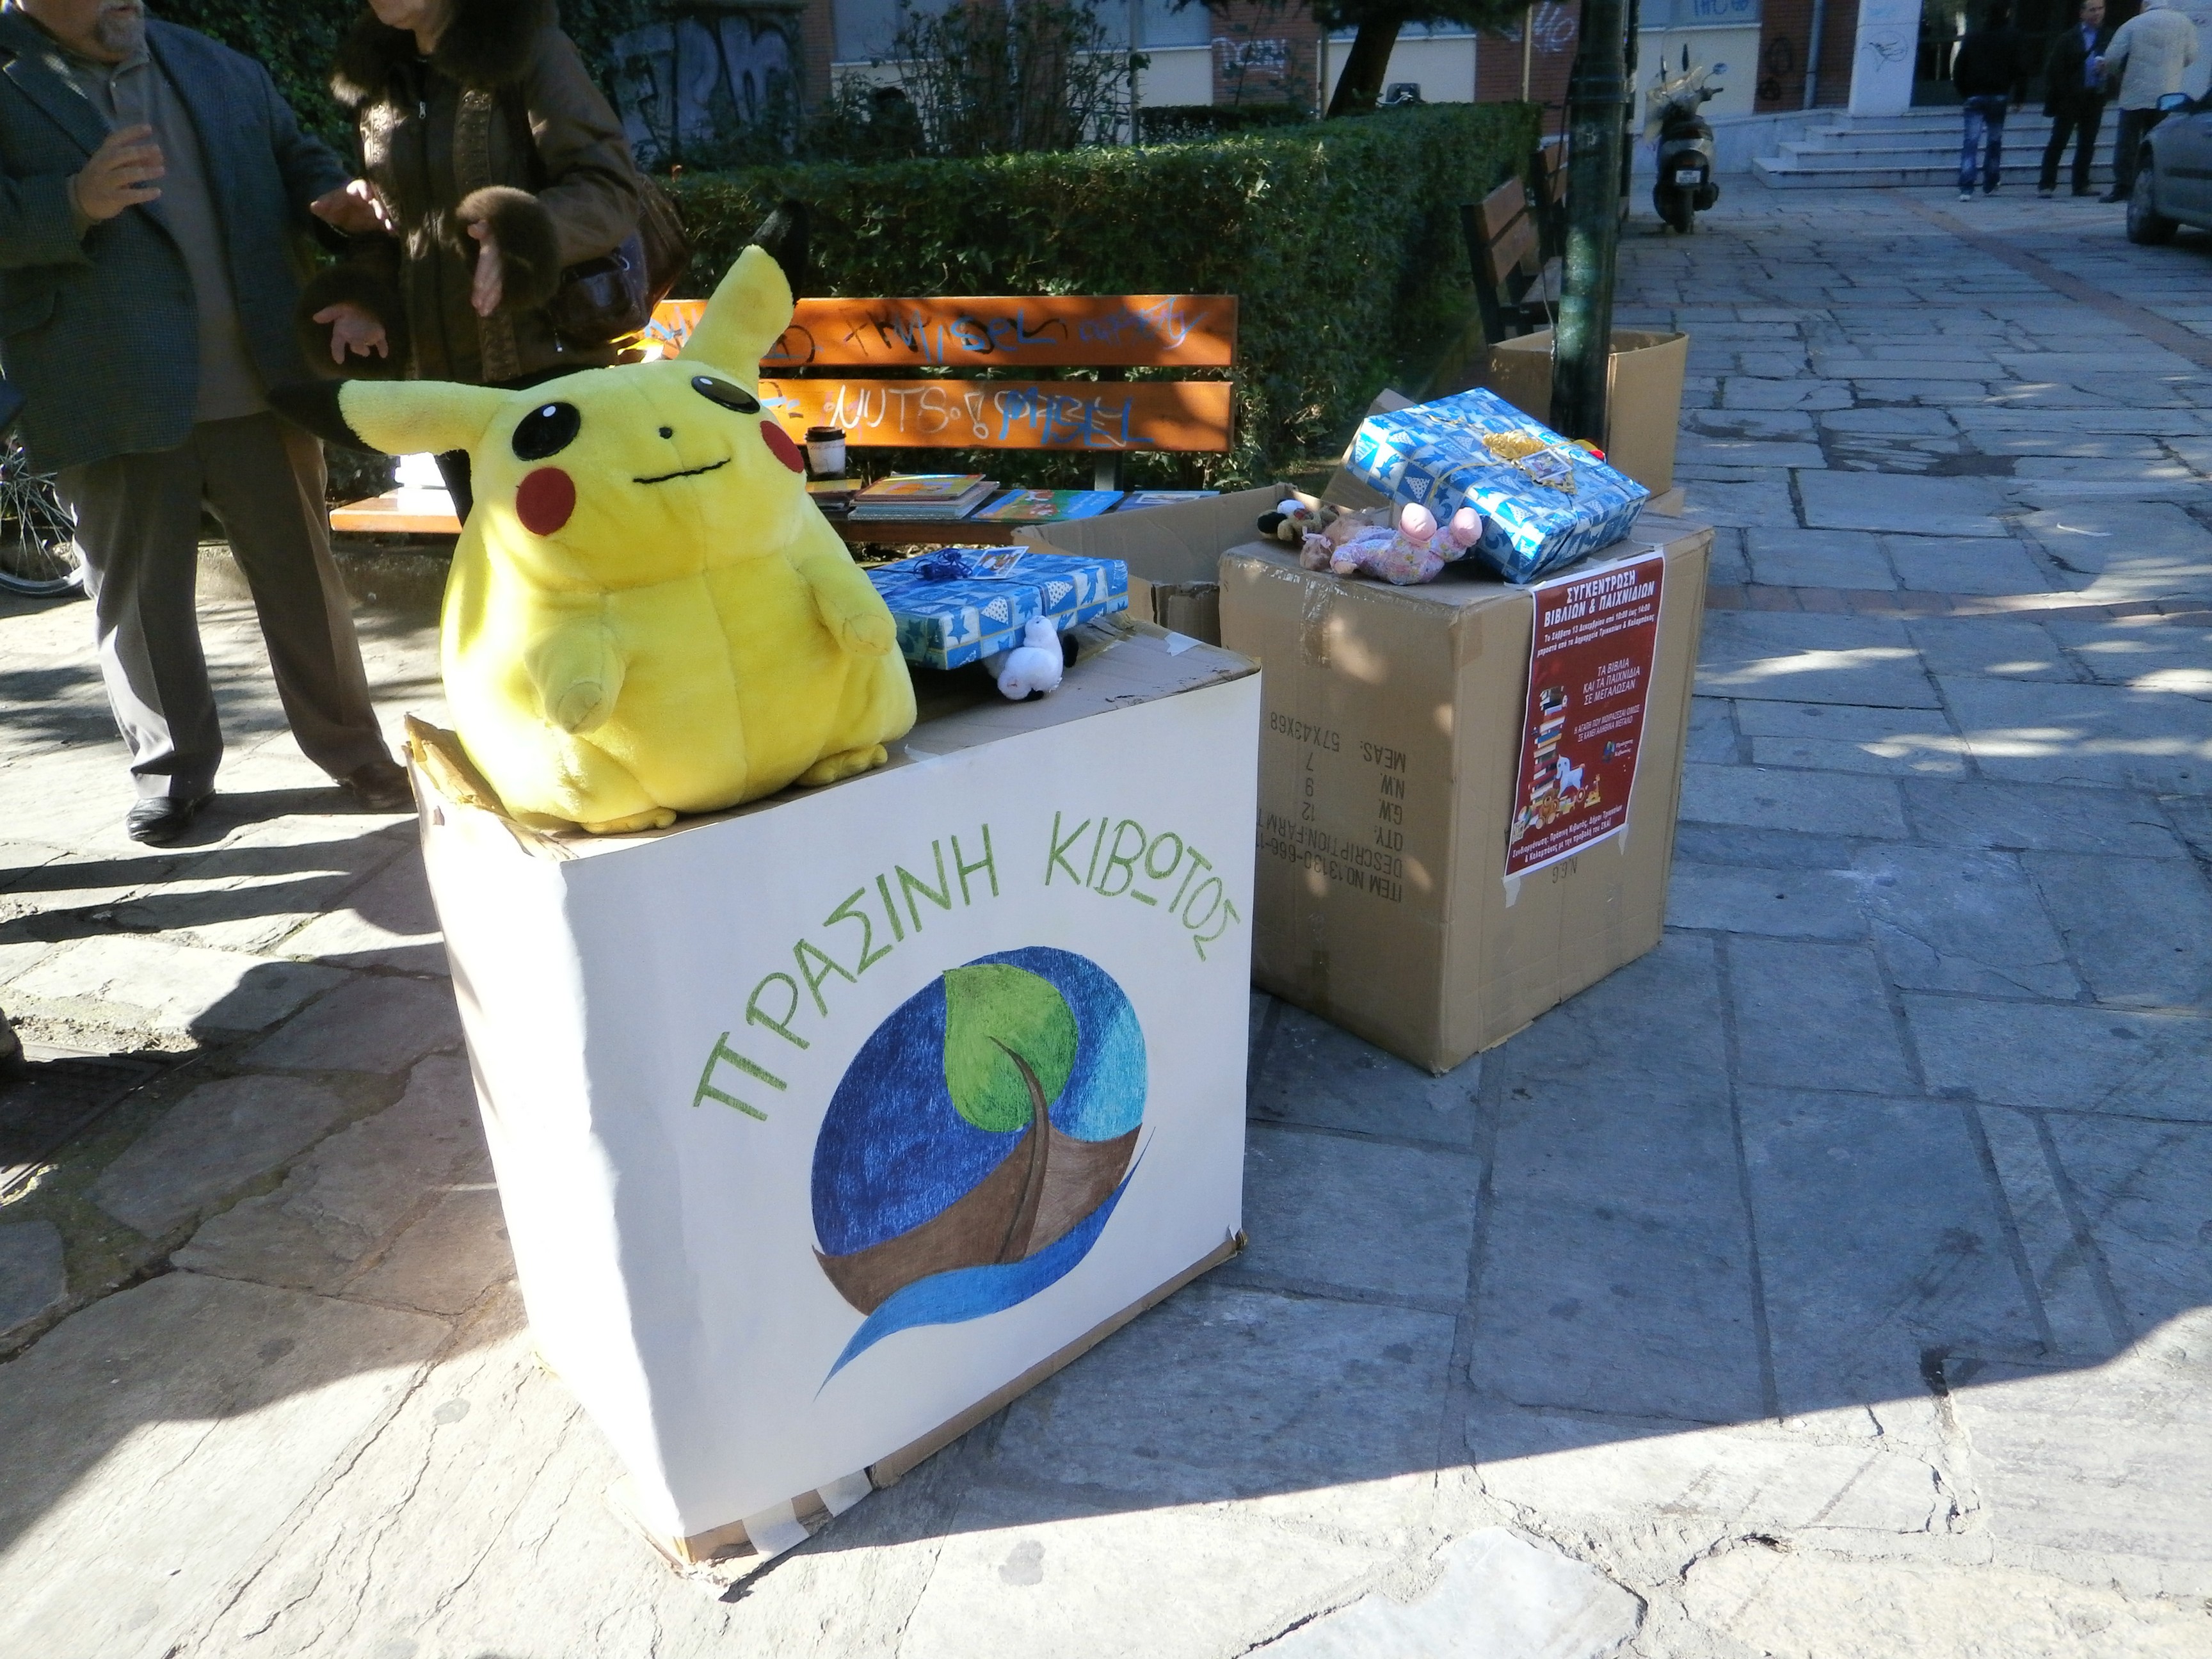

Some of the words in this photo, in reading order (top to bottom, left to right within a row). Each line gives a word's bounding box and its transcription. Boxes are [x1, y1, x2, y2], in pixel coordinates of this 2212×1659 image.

[1567, 570, 1635, 603] ΣΥΓΚΕΝΤΡΩΣΗ
[1544, 602, 1585, 627] ΒΙΒΛΙΩΝ
[1589, 598, 1596, 614] &
[1599, 582, 1655, 610] ΠΑΙΧΝΙΔΙΩΝ
[1544, 634, 1551, 643] Το
[1551, 629, 1571, 641] Σάββατο
[1573, 625, 1578, 634] 13
[1639, 604, 1651, 613] 14:00
[1583, 681, 1595, 694] ΚΑΙ
[1597, 678, 1605, 689] ΤΑ
[1607, 666, 1640, 685] ΠΑΙΧΝΙΔΙΑ
[1598, 665, 1606, 677] ΤΑ
[1607, 658, 1629, 673] ΒΙΒΛΙΑ
[1584, 693, 1593, 705] ΣΕ
[1594, 679, 1635, 701] ΜΕΓΑΛΩΣΑΝ
[1270, 711, 1340, 753] 57X43X68
[1305, 752, 1314, 772] 7
[1360, 740, 1407, 773] MEAS:
[1304, 776, 1314, 797] 9
[1380, 773, 1405, 800] N.W.
[1301, 801, 1316, 822] 12
[1374, 825, 1403, 852] QTY:
[1370, 873, 1403, 903] ITEM
[693, 822, 1000, 1122] ΠΡΑΣΙΝΗ
[1044, 810, 1241, 963] ΚΙΒΩΤΟΣ
